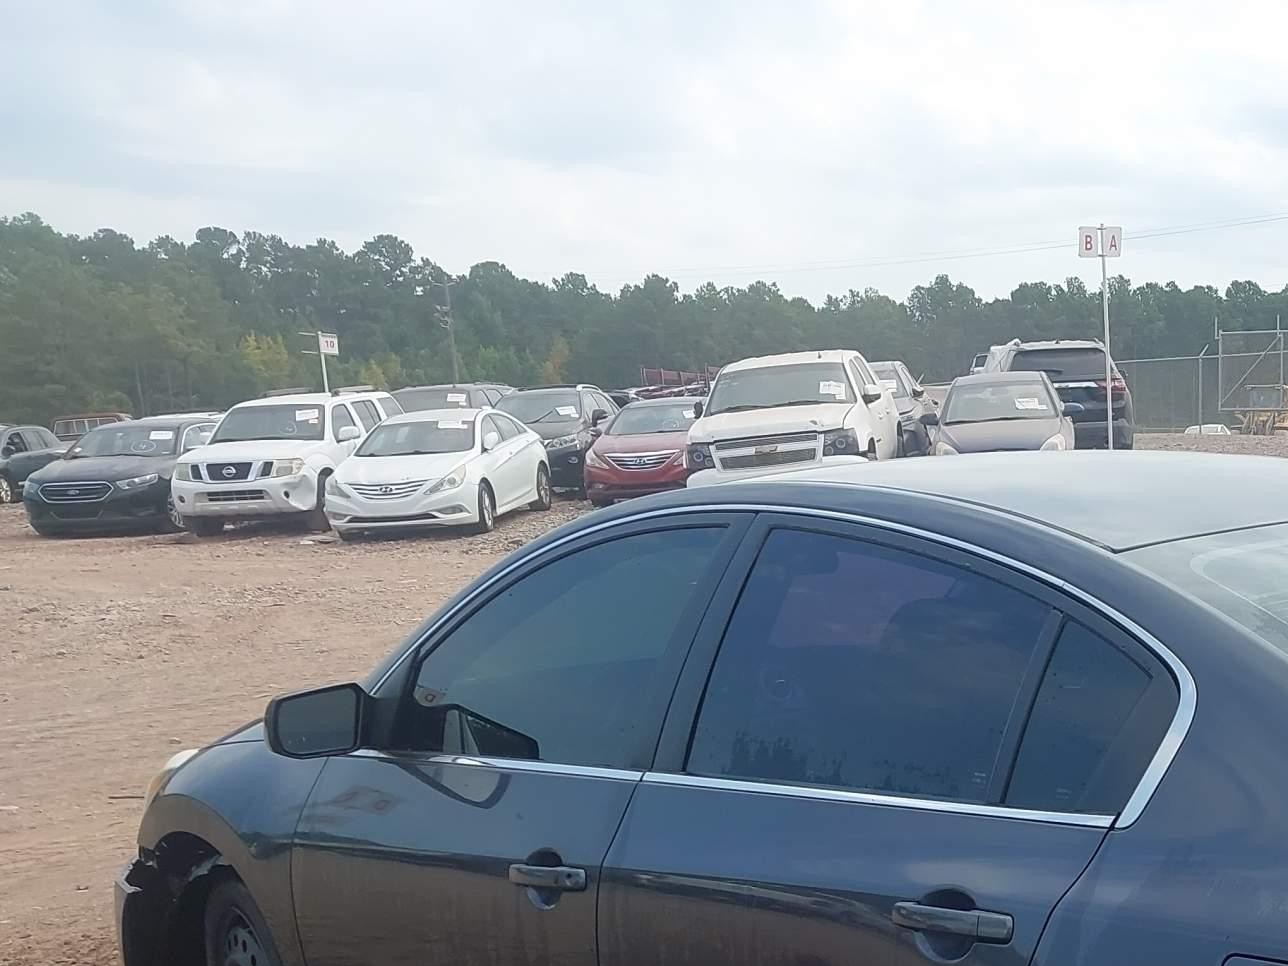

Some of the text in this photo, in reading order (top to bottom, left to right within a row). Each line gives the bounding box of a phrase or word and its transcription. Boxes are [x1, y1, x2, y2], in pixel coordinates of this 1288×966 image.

[1084, 234, 1093, 251] B
[1108, 234, 1118, 251] A
[324, 340, 335, 349] 10
